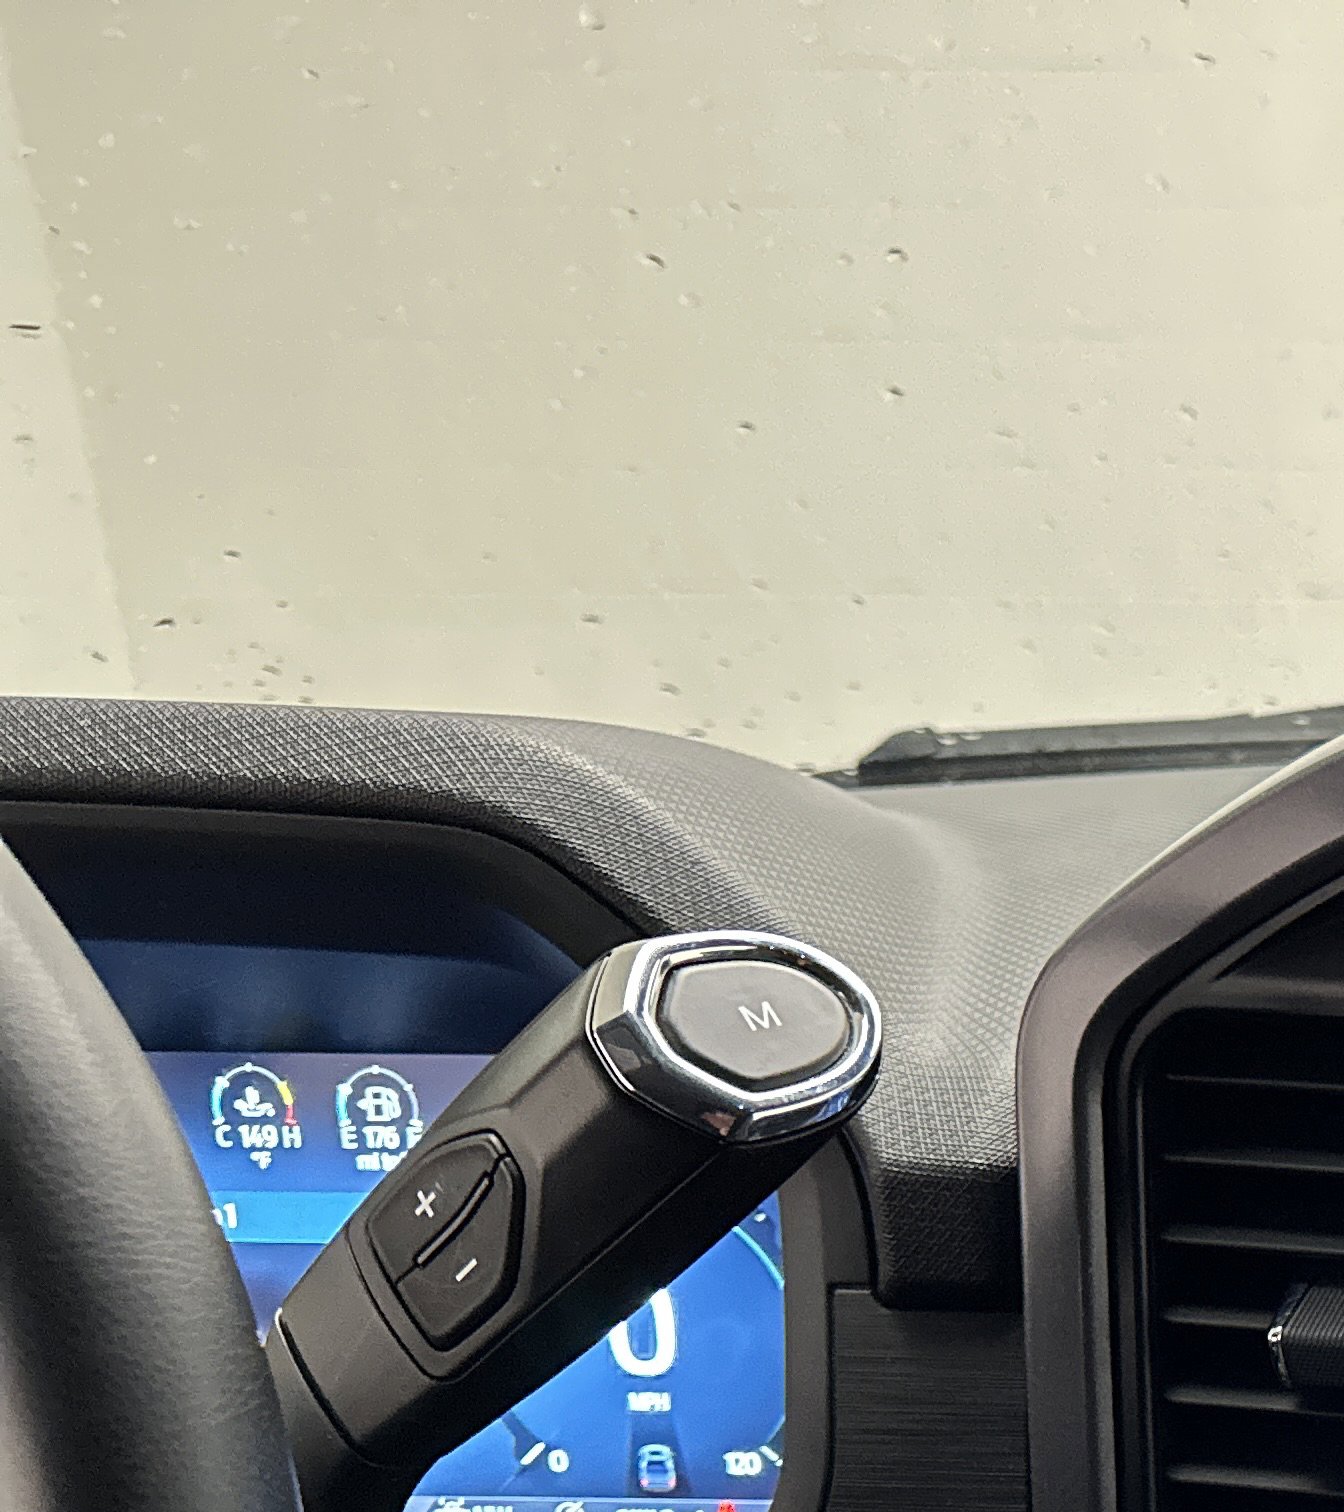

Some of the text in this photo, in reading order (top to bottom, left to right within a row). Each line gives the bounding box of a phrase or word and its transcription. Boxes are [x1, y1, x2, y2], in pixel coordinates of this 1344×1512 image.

[738, 1000, 783, 1032] M
[214, 1124, 303, 1149] C 149 H
[338, 1125, 359, 1150] E
[361, 1125, 401, 1150] 176
[547, 1449, 570, 1473] 0
[722, 1451, 762, 1476] 120
